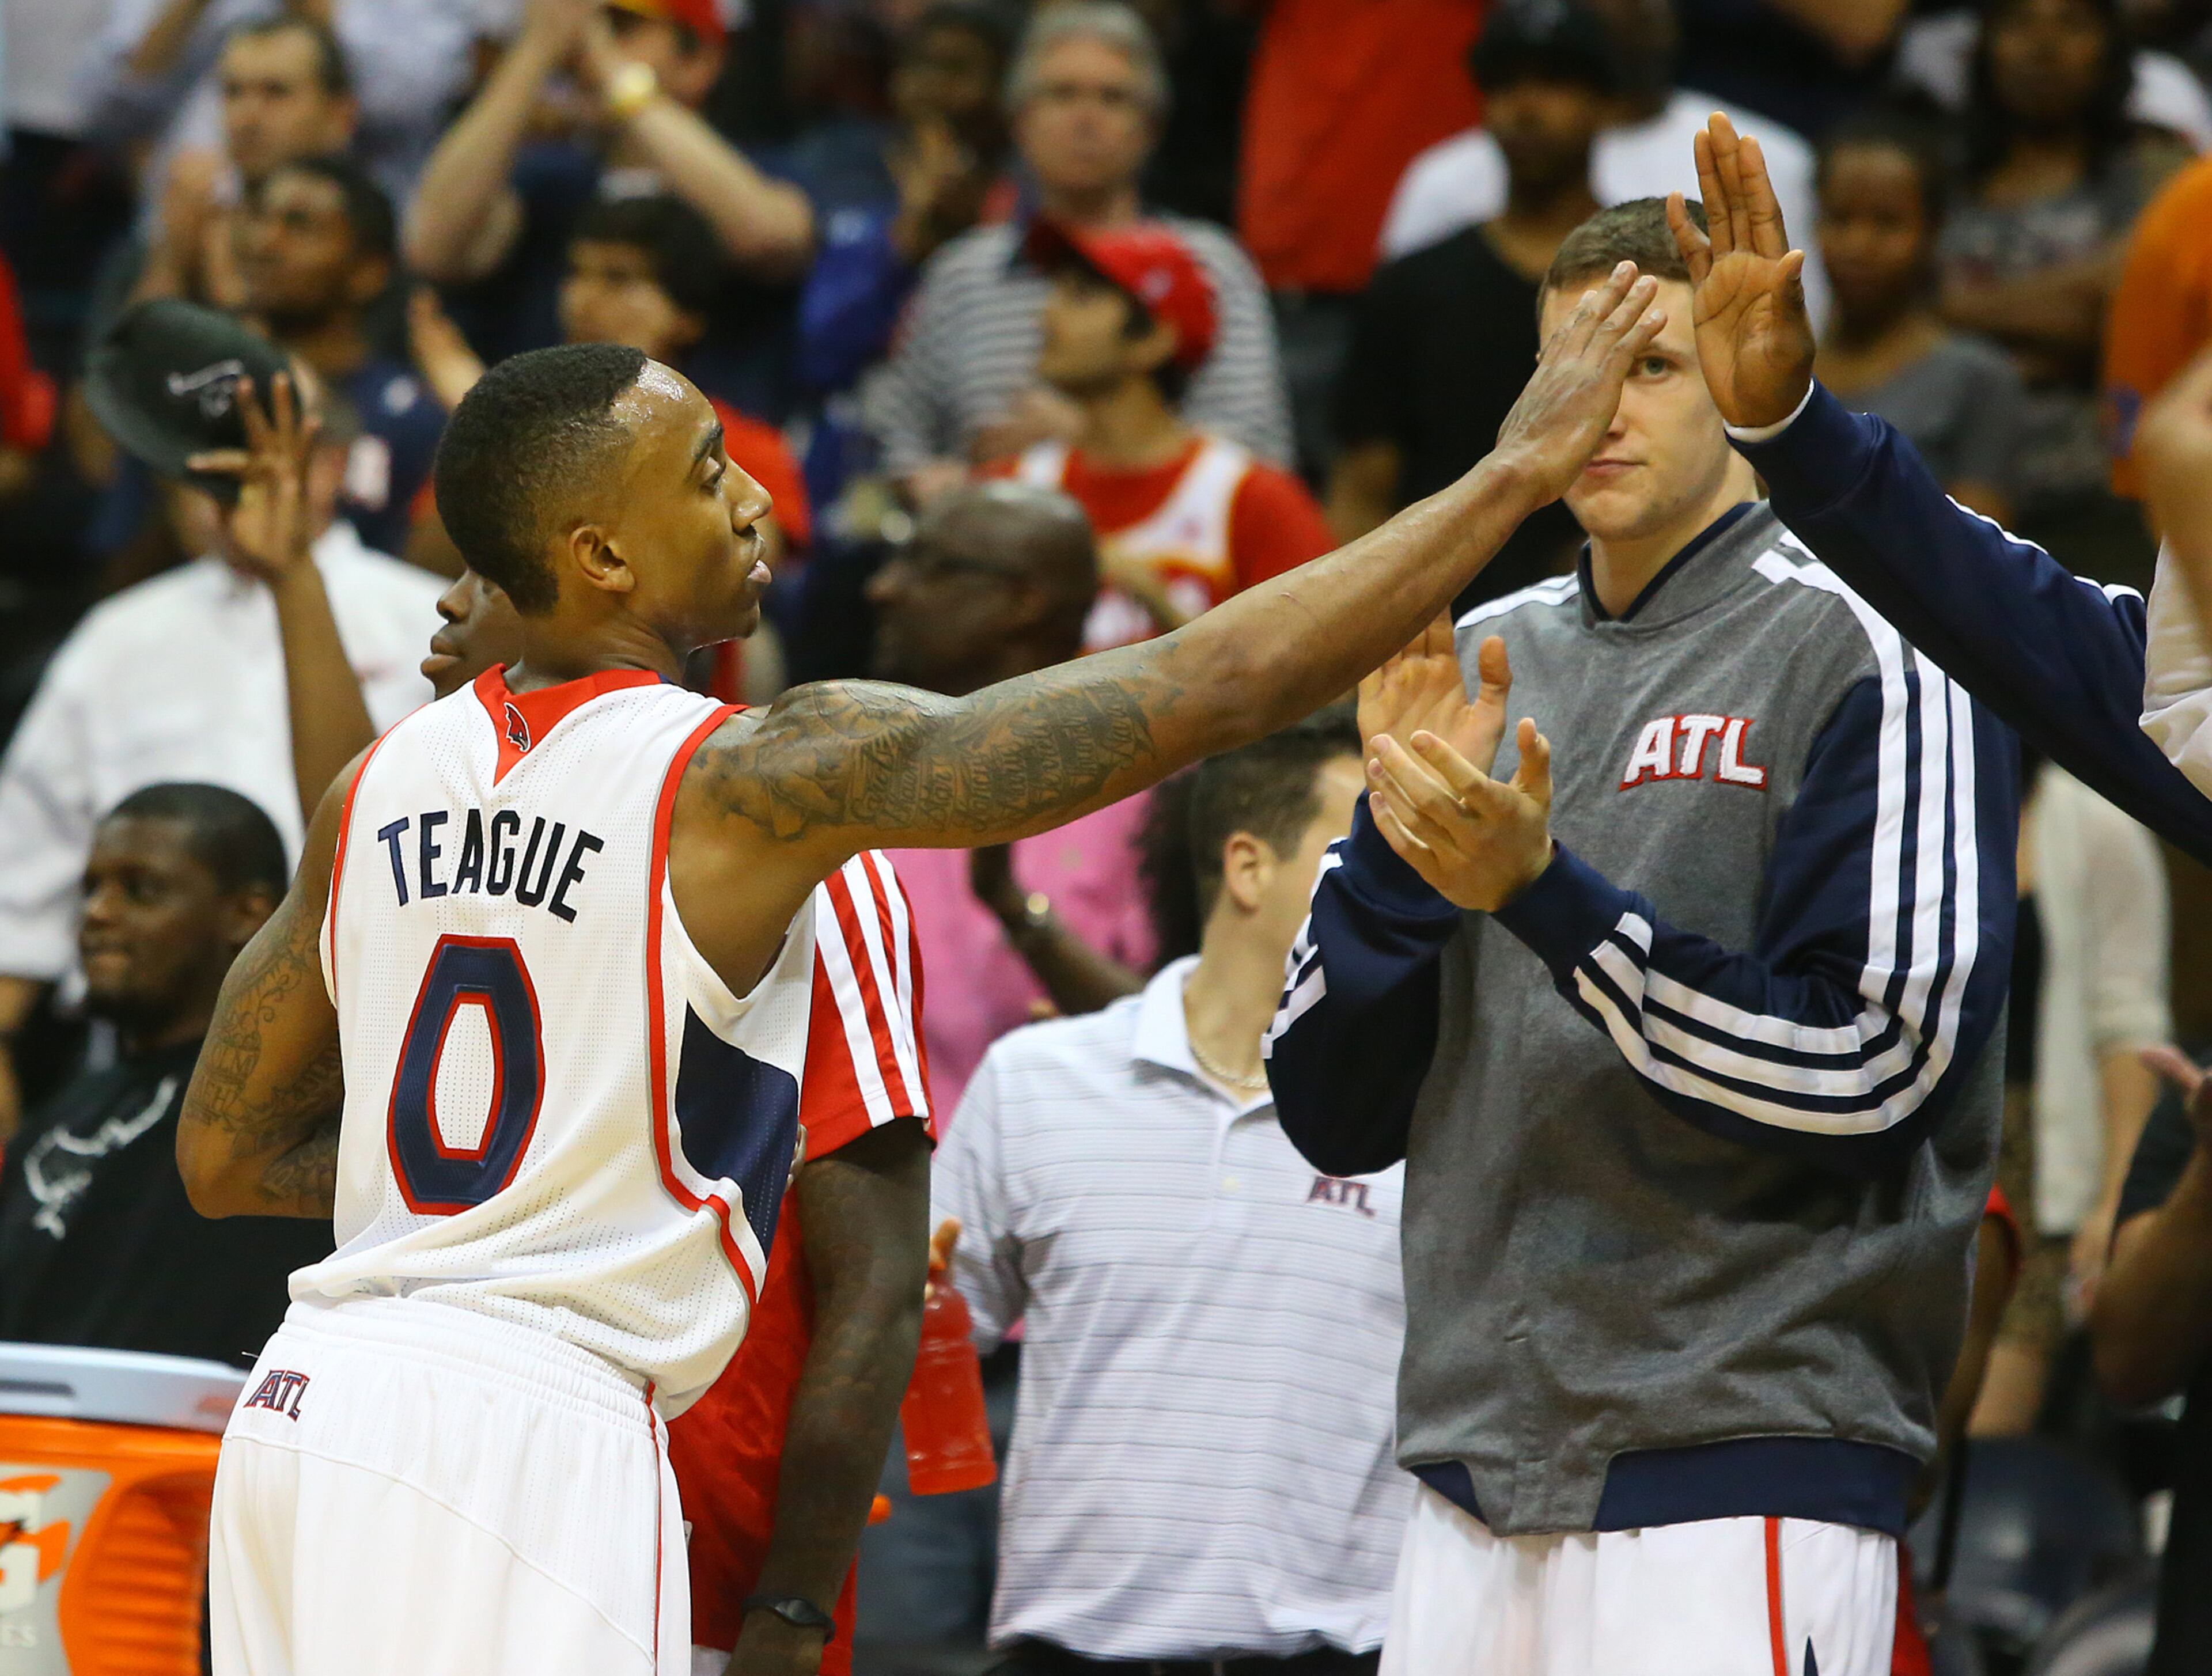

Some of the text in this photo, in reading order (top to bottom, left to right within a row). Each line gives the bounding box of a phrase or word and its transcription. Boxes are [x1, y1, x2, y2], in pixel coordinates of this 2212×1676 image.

[1619, 714, 1767, 792] ATL
[378, 809, 604, 922] TEAGUE
[387, 933, 546, 1215] 0
[1305, 1176, 1376, 1218] ATL
[243, 1369, 310, 1422] ATL
